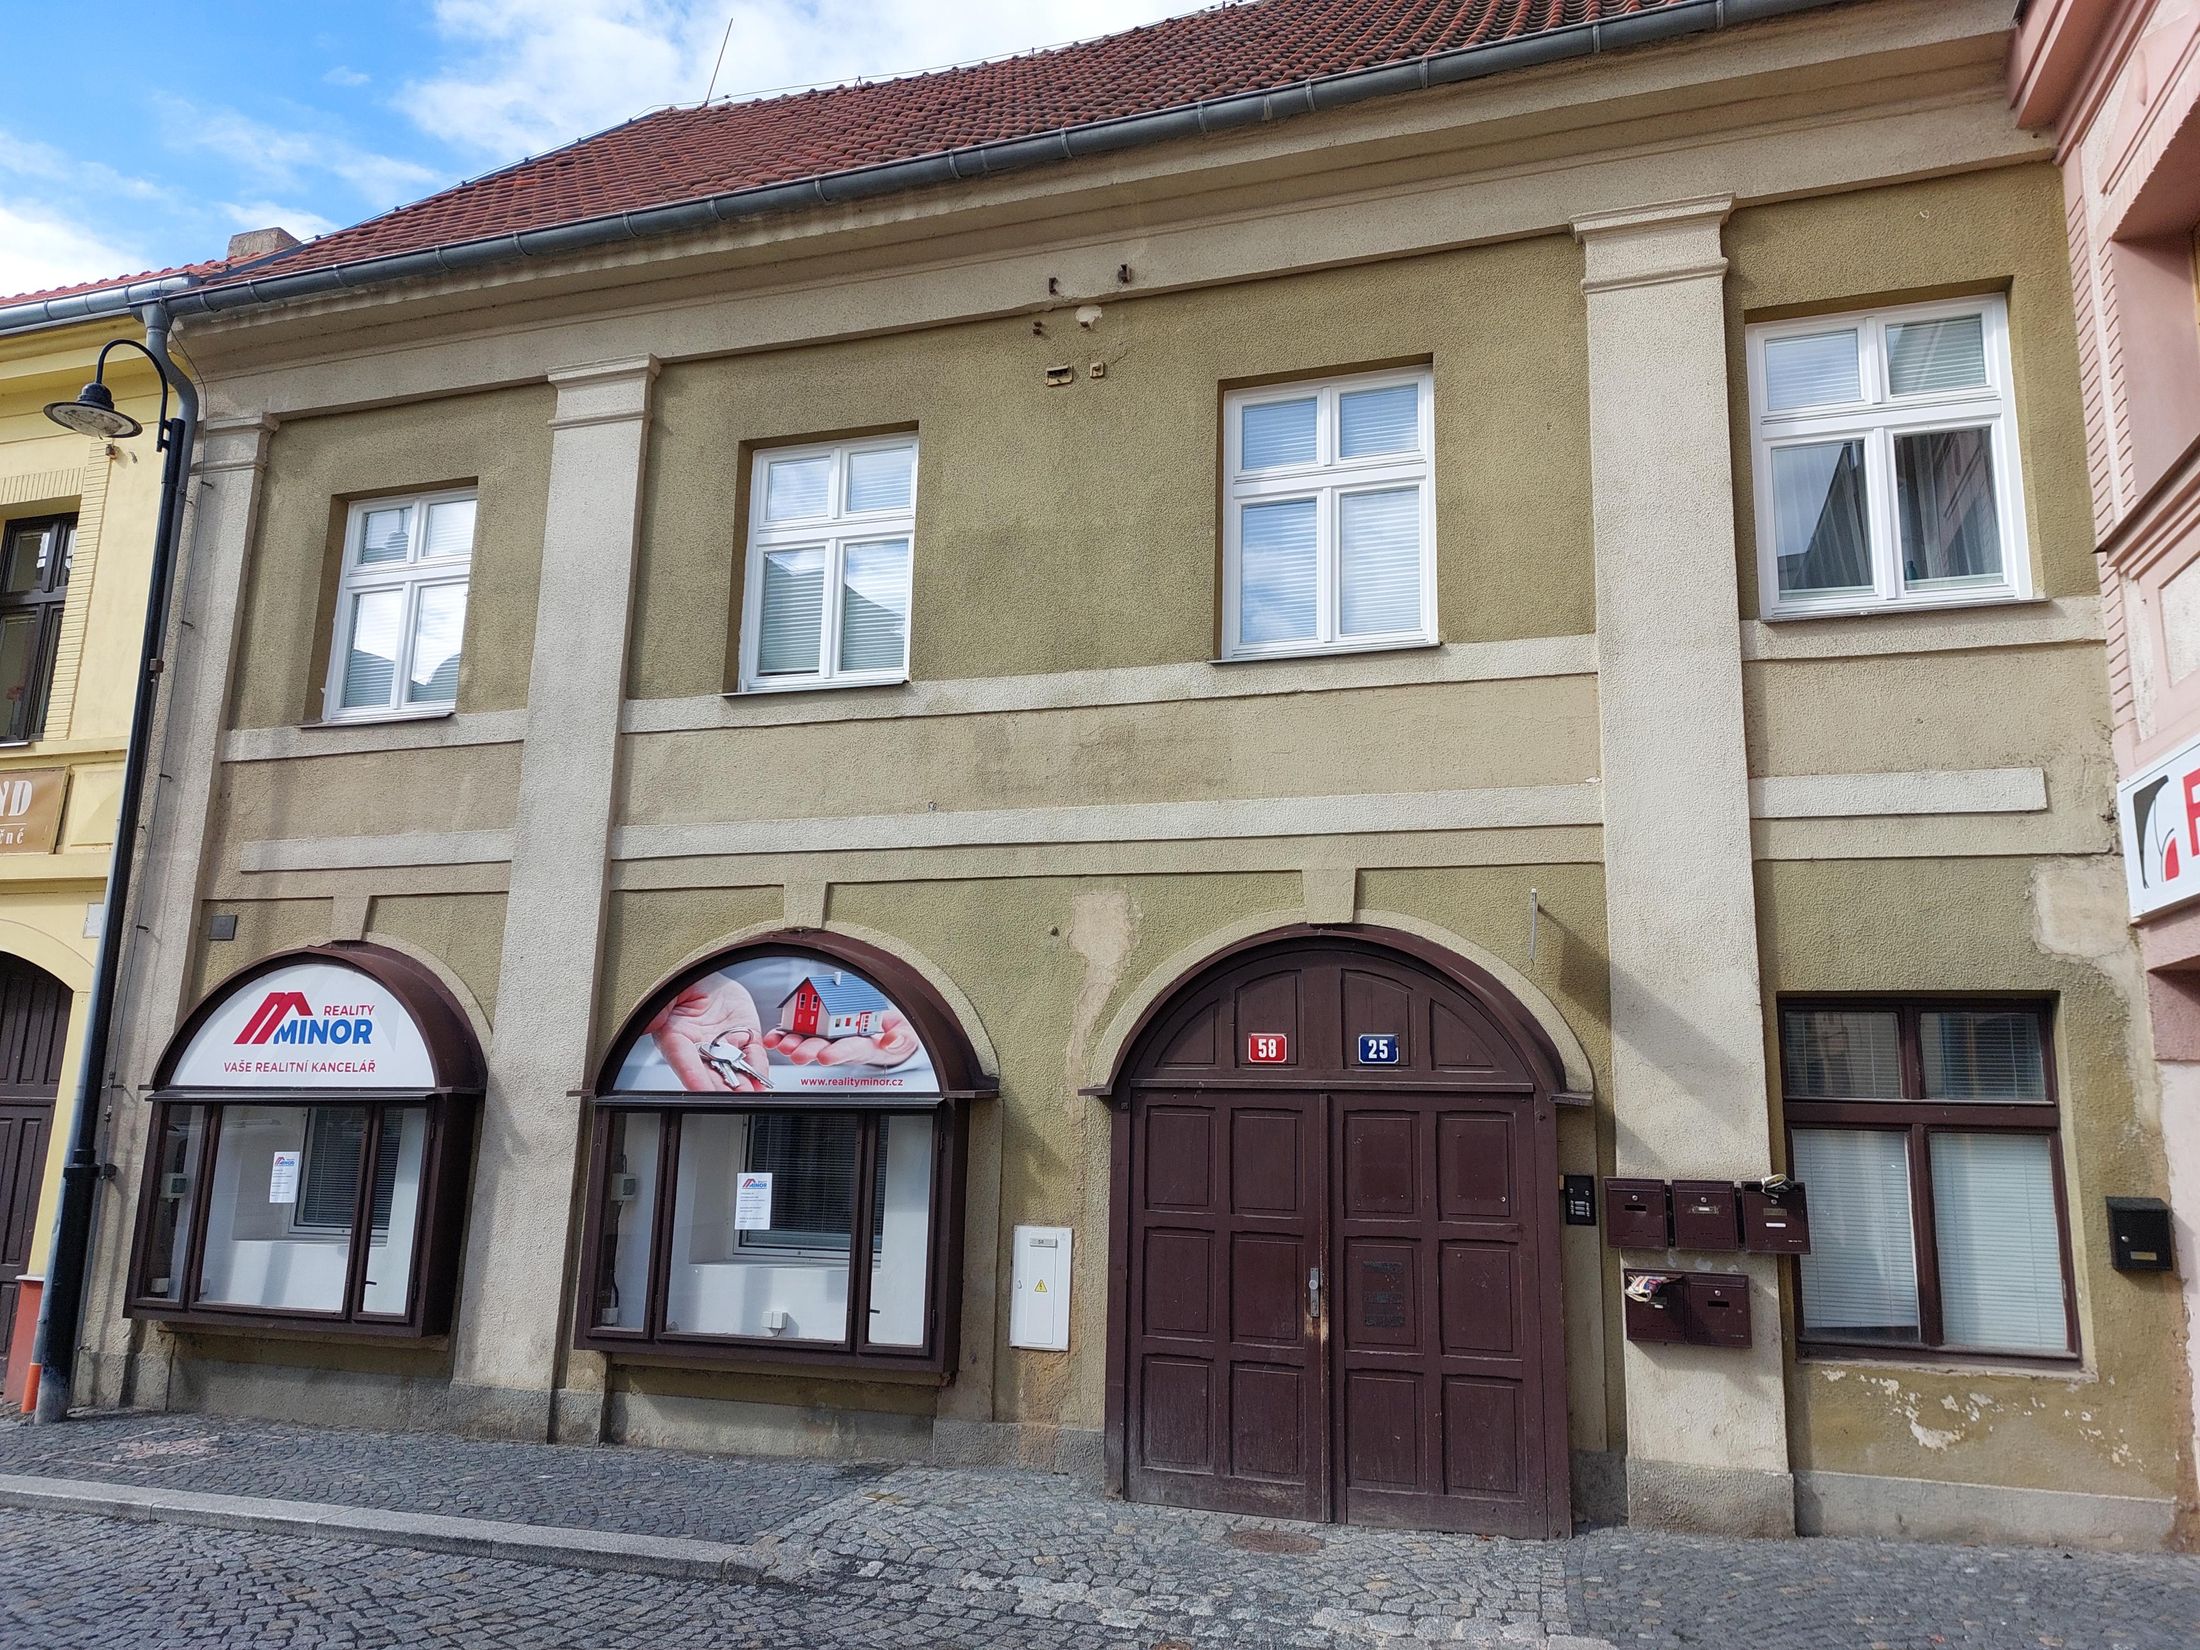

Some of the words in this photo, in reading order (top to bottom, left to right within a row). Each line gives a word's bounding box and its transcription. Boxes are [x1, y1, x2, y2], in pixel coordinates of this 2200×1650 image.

[323, 1005, 375, 1016] REALITY
[273, 1019, 373, 1045] MINOR
[1258, 1038, 1277, 1058] 58
[1368, 1039, 1389, 1059] 25
[224, 1059, 252, 1073] VAŠE
[255, 1060, 309, 1073] REALITNÍ
[311, 1060, 376, 1073] KANCELÁŘ
[800, 1077, 904, 1087] www.realityminor.cz
